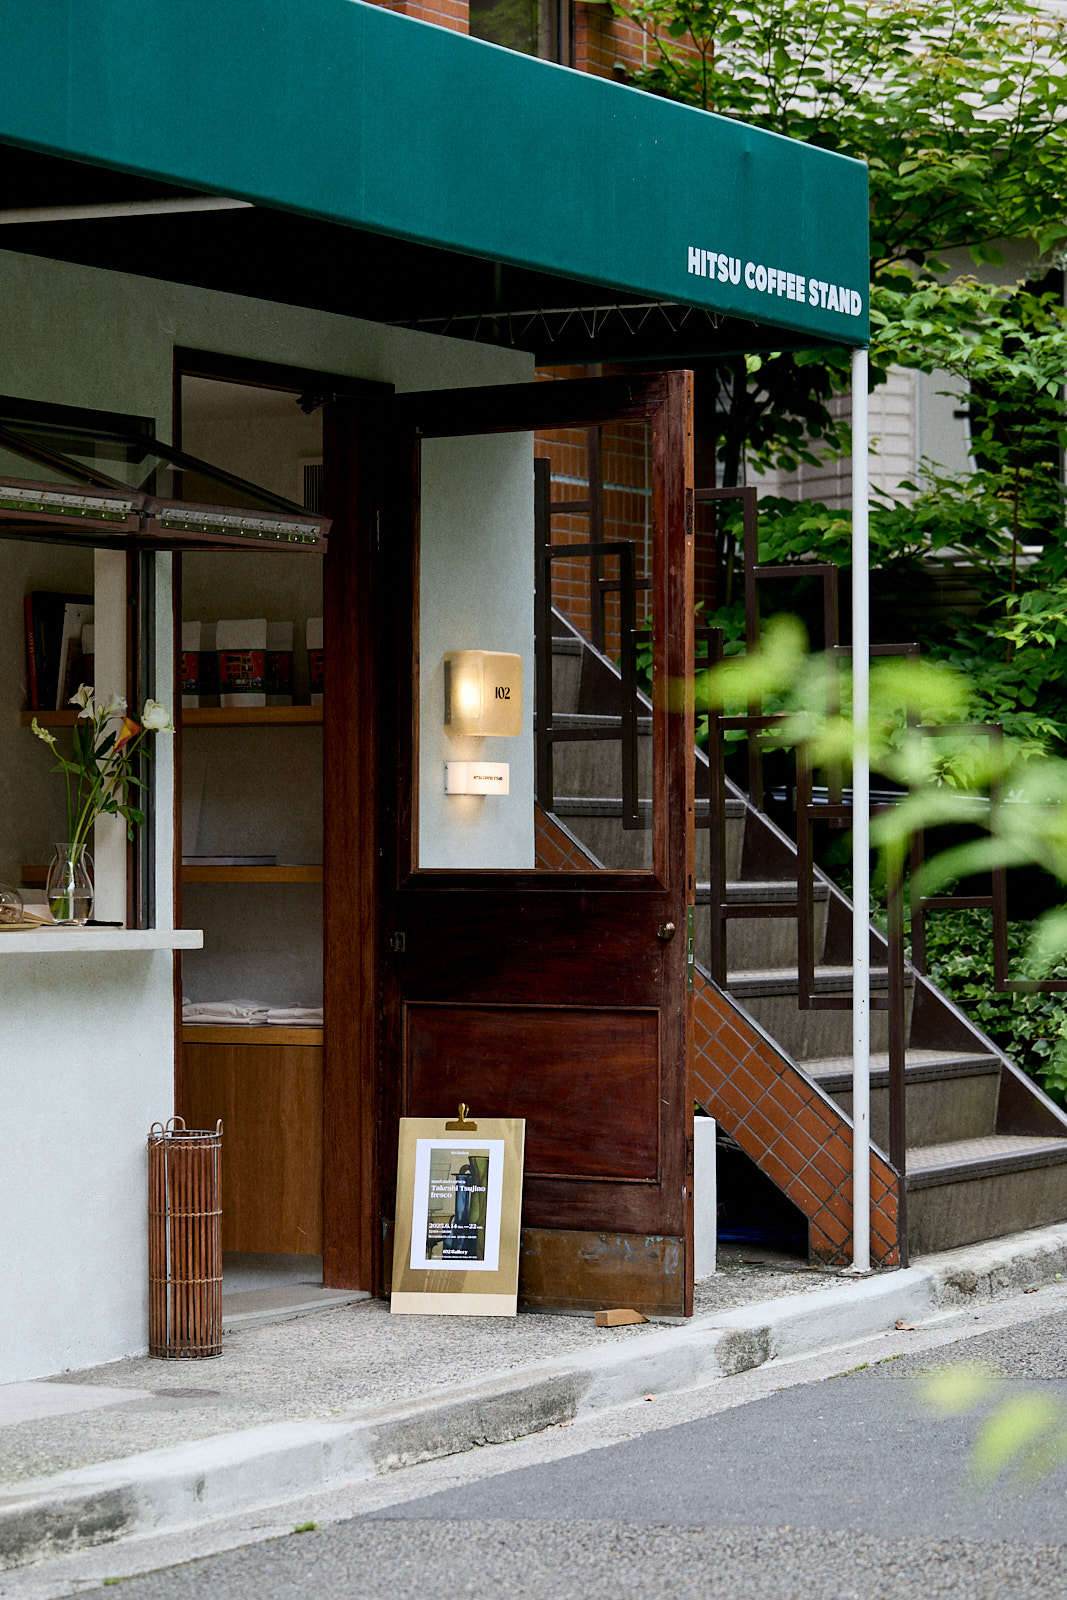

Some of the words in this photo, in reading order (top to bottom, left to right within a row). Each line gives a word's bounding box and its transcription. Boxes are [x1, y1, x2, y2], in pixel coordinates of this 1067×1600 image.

[687, 246, 742, 285] HITSU
[744, 262, 806, 303] COFFEE
[808, 278, 863, 317] STAND
[495, 686, 511, 700] 102
